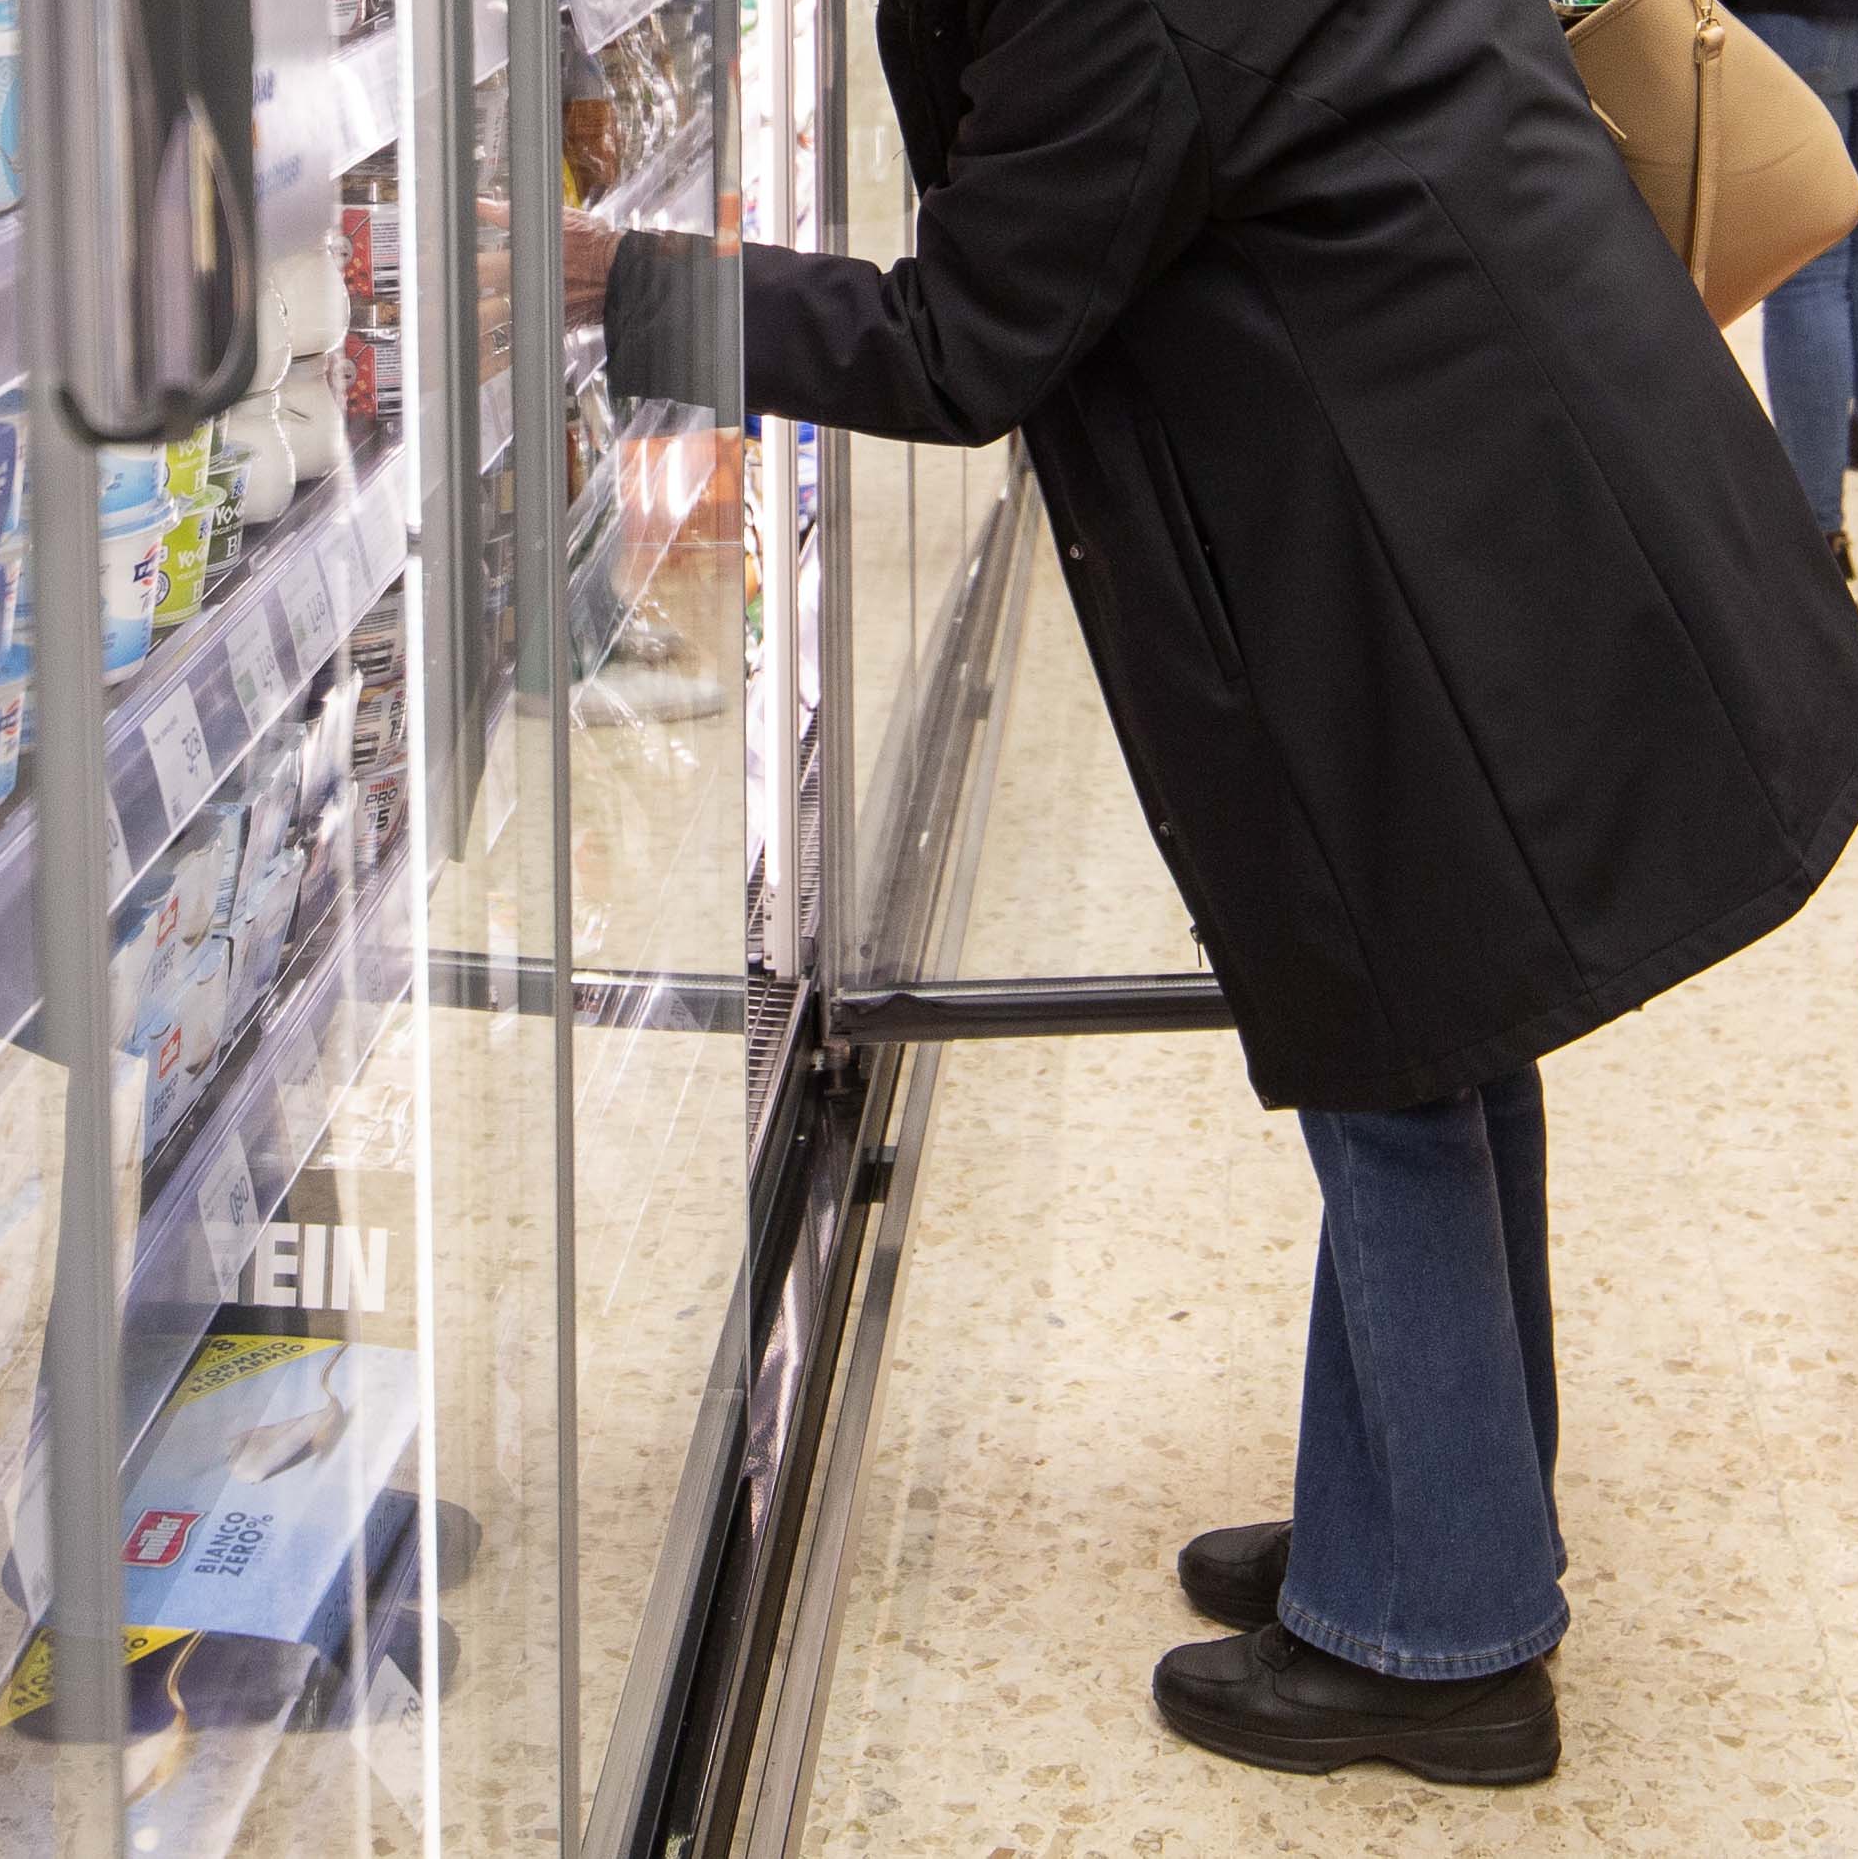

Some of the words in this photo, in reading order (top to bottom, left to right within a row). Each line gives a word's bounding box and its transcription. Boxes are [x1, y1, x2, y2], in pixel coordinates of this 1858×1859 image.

[364, 787, 399, 807] PRO
[366, 805, 391, 832] 15
[193, 1511, 248, 1575] BIANCO
